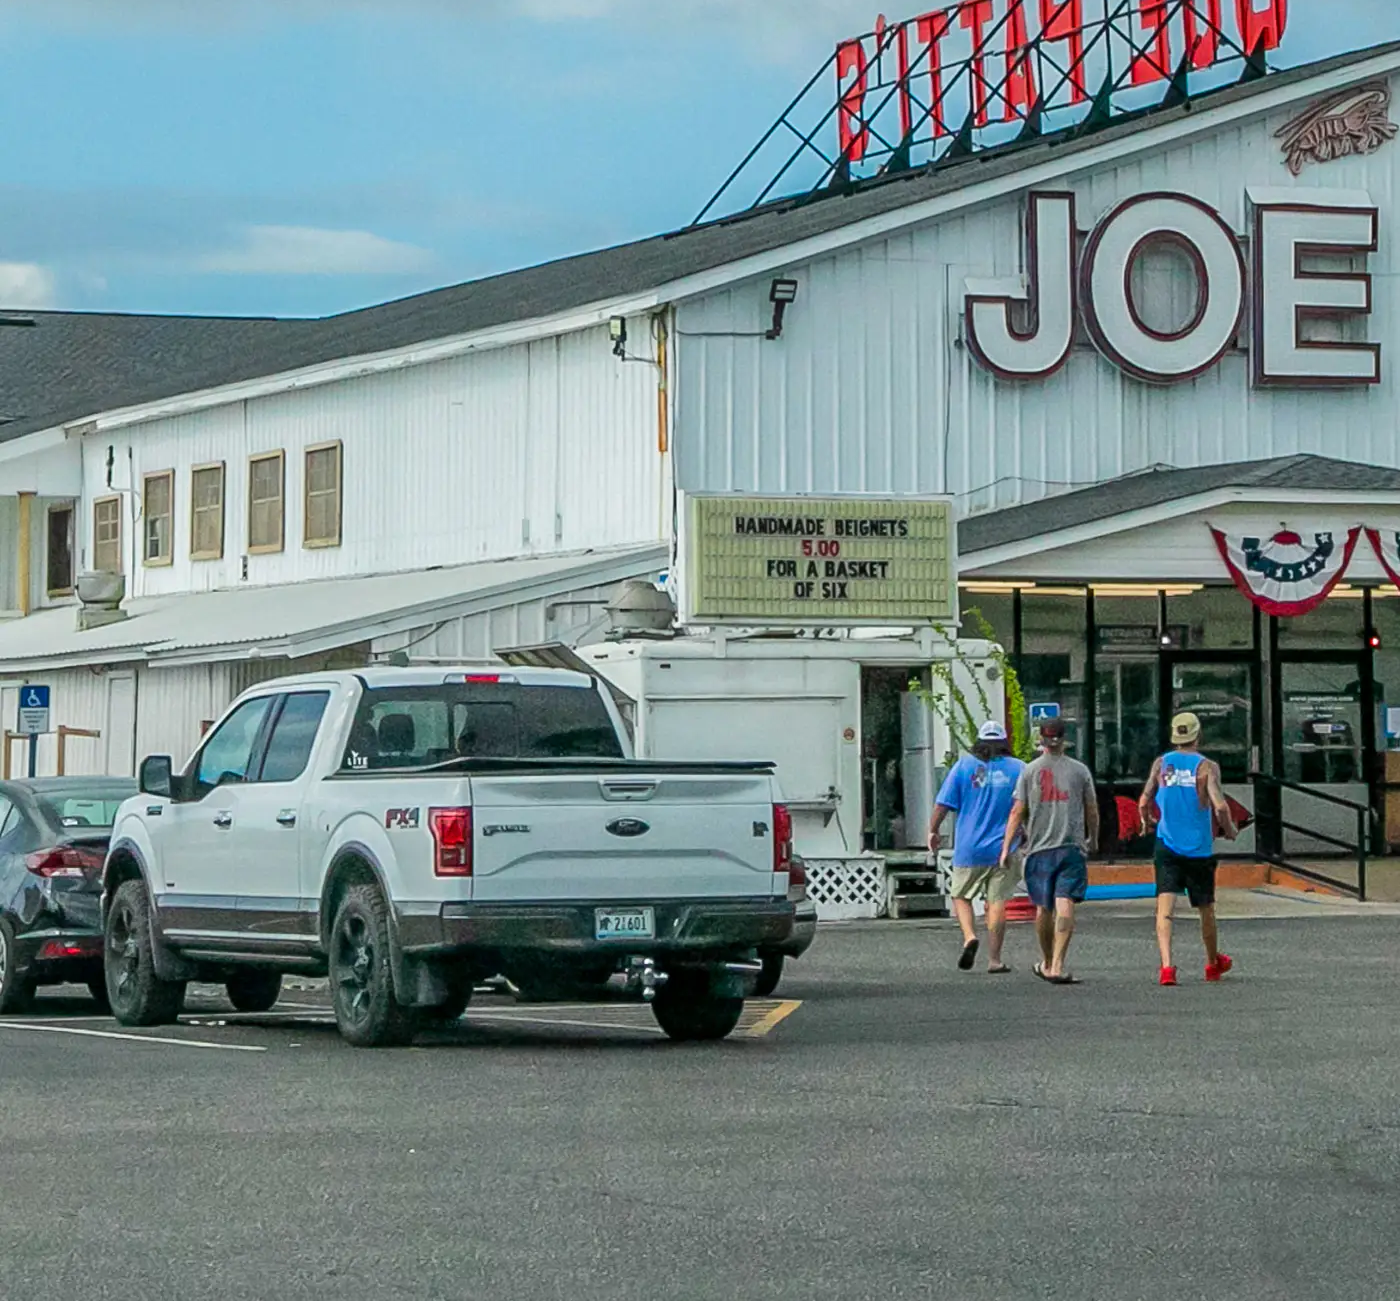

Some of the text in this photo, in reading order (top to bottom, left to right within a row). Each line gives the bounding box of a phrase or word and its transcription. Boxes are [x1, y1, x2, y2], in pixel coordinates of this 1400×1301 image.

[964, 190, 1381, 387] JOE
[735, 516, 908, 537] HANDMADE BEIGNETS
[801, 539, 841, 557] 5.00
[766, 559, 889, 579] FOR A BASKET
[793, 581, 848, 599] OF SIX
[386, 807, 420, 829] FX4
